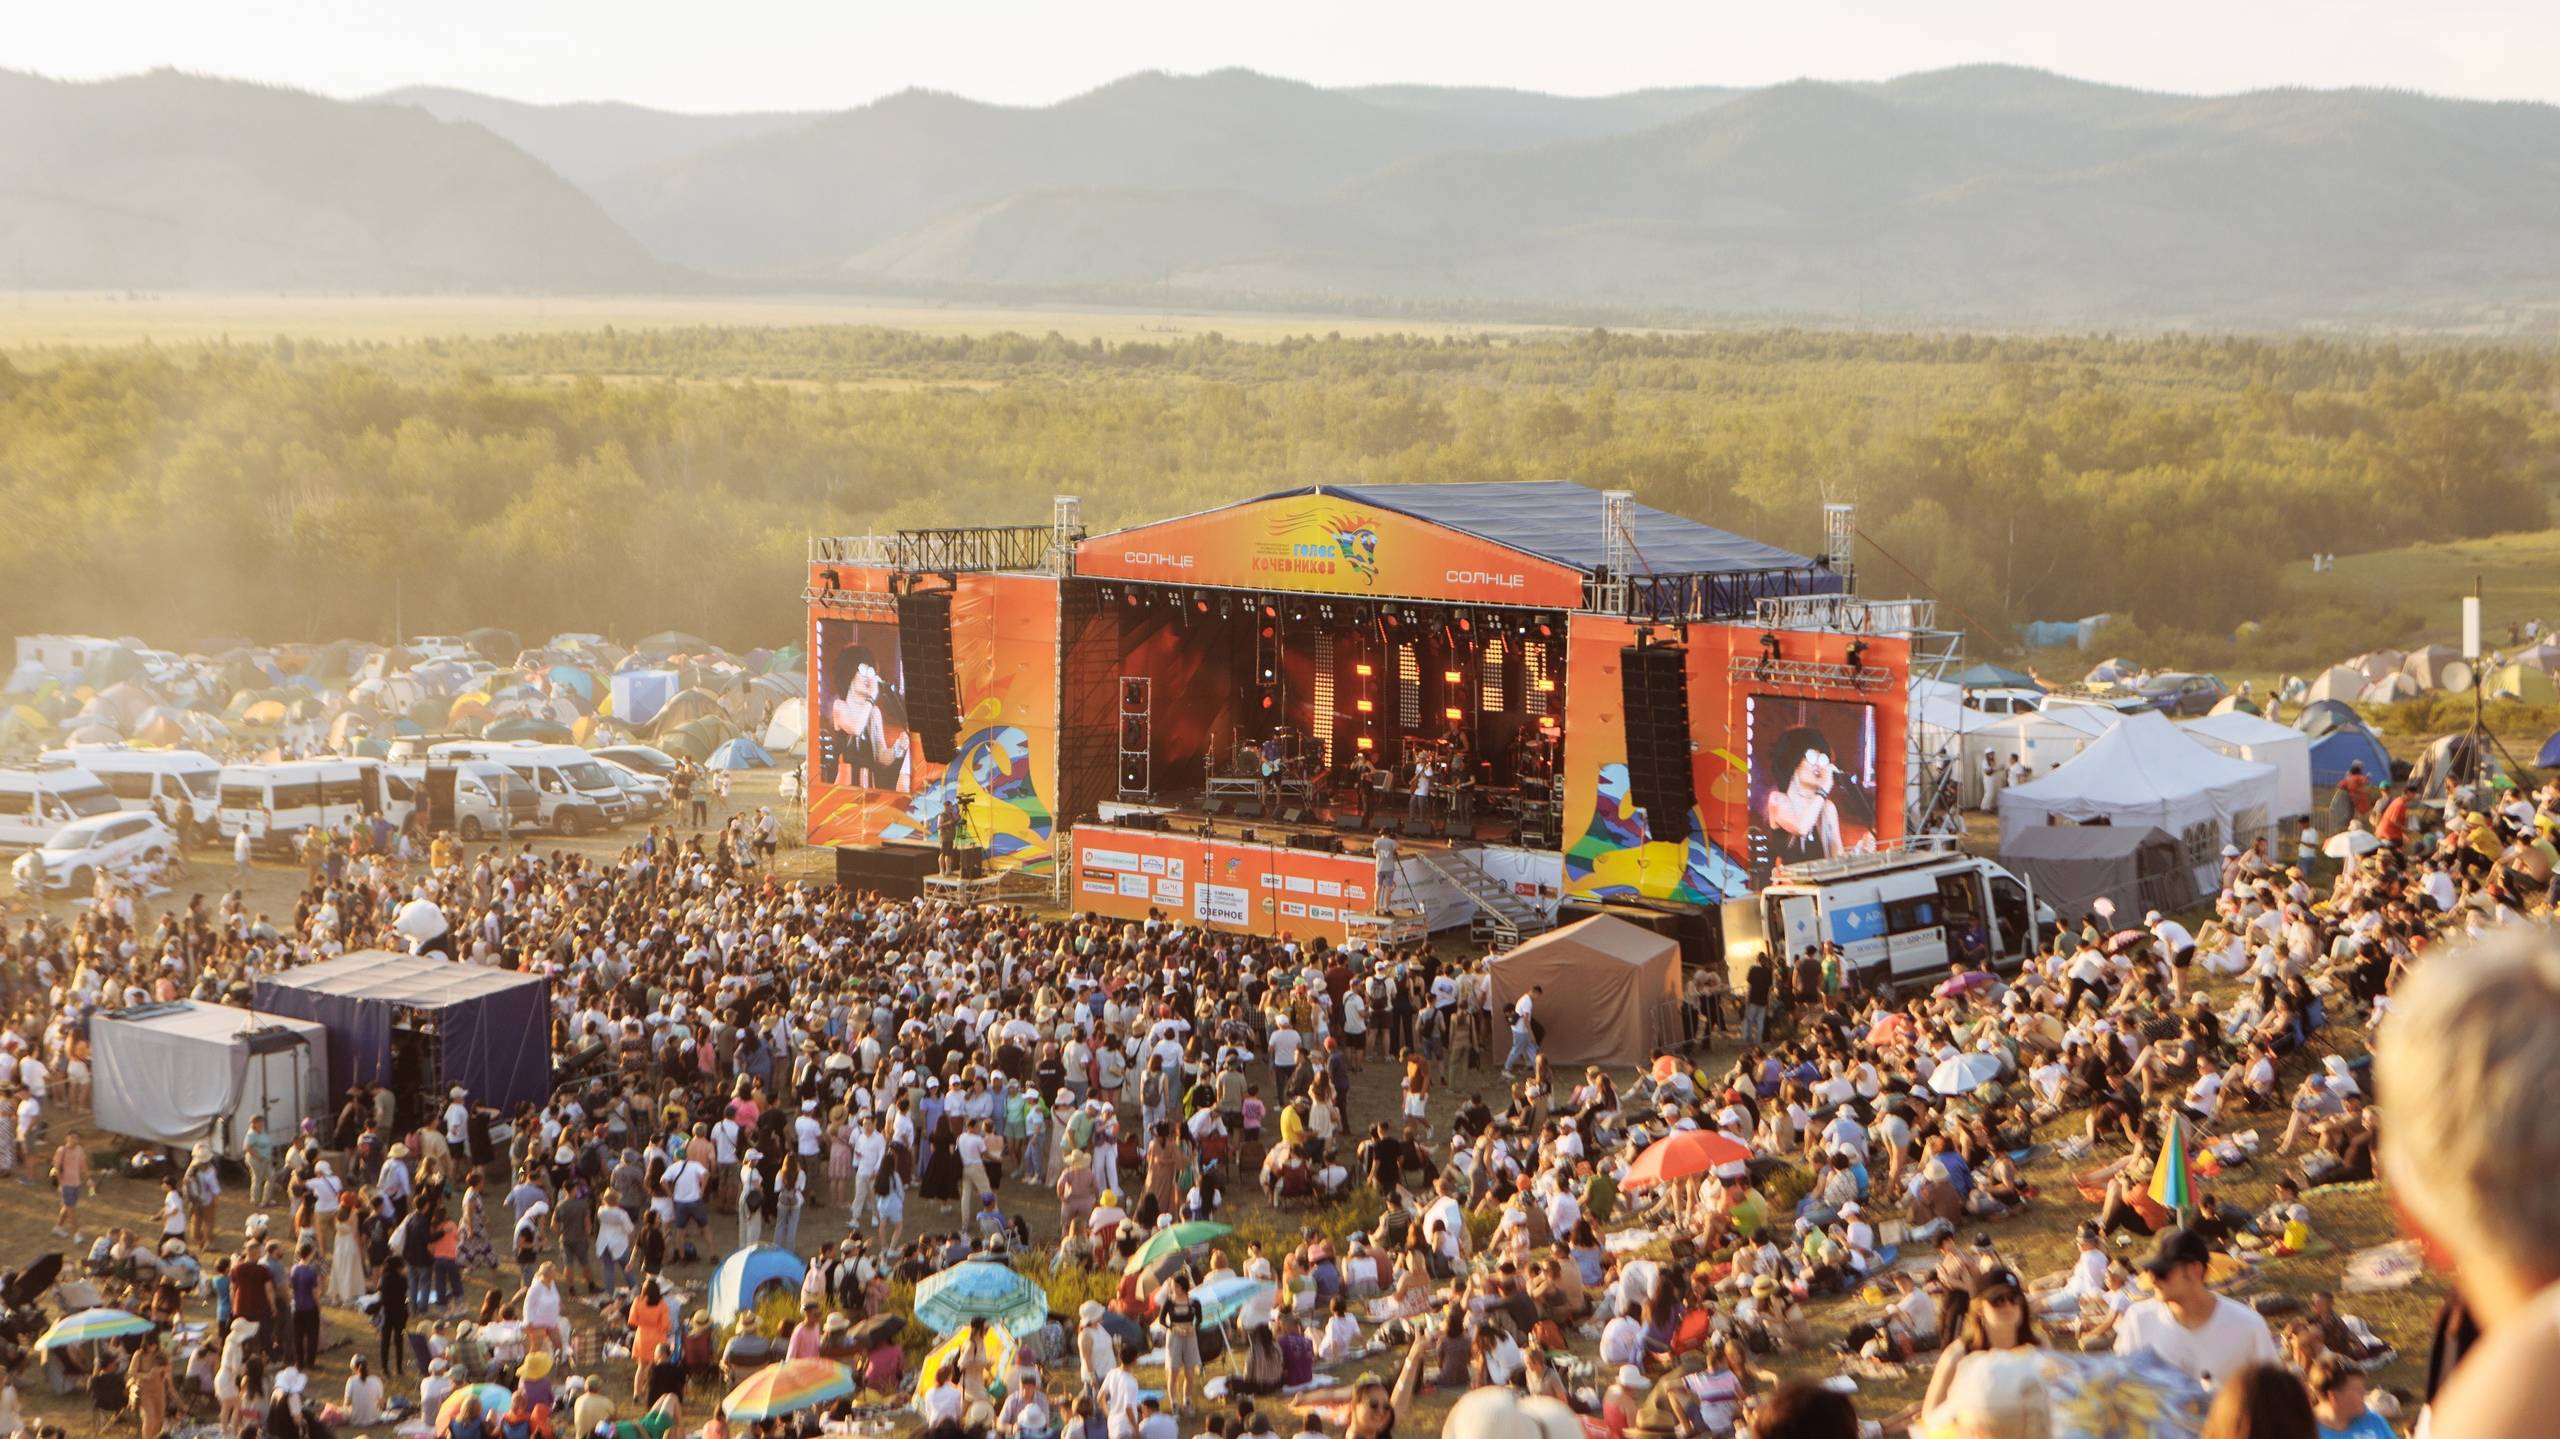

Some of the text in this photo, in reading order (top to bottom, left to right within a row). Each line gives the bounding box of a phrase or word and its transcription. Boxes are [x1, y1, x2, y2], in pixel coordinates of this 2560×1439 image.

[1124, 551, 1194, 568] СОЛНЦЕ
[1293, 544, 1335, 558] ГОЛОС
[1252, 557, 1336, 575] КОЧЕВНИКОВ
[1446, 571, 1524, 588] СОЛНЦЕ
